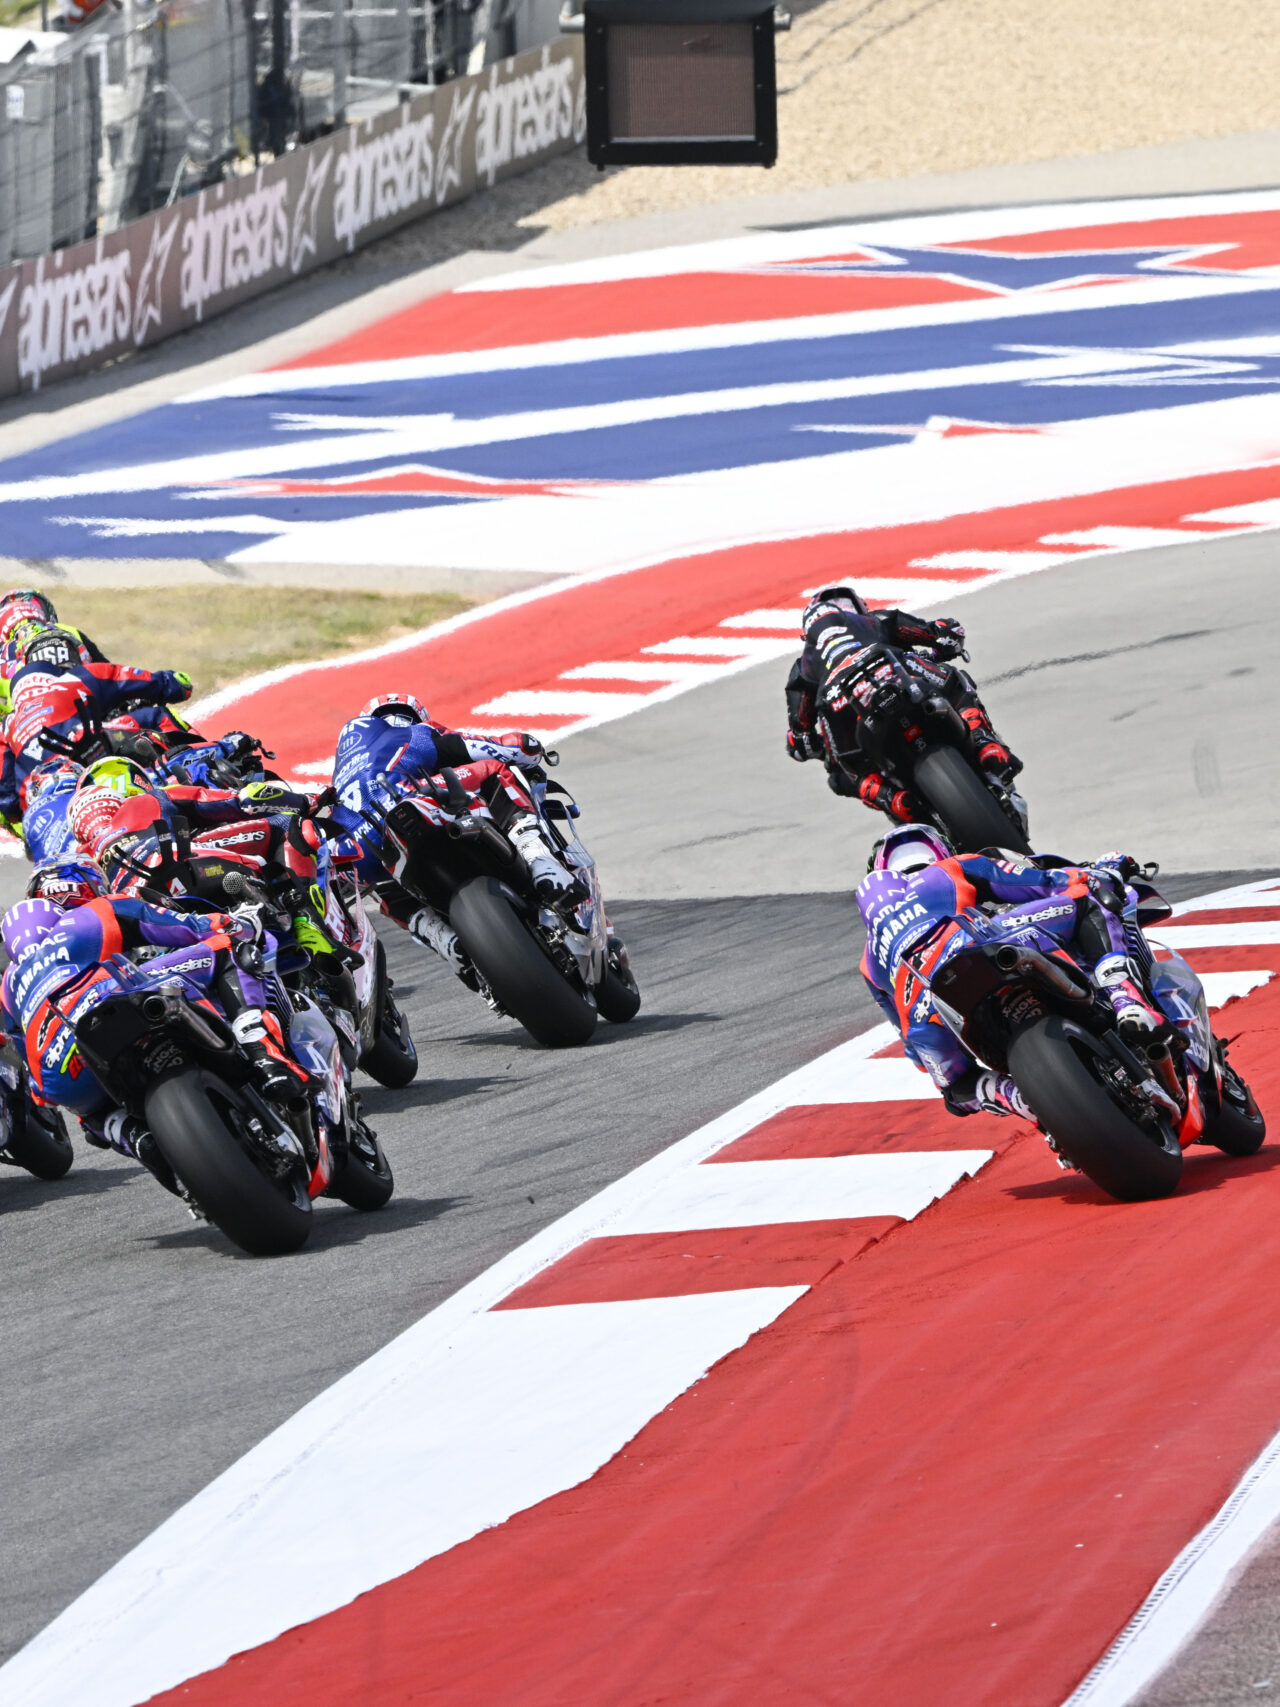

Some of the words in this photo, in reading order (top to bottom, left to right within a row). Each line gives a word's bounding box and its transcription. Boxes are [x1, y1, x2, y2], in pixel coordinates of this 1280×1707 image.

[879, 903, 928, 969] YAMAHA
[1001, 904, 1074, 928] alpinestars
[15, 946, 70, 1010] YAMAHA
